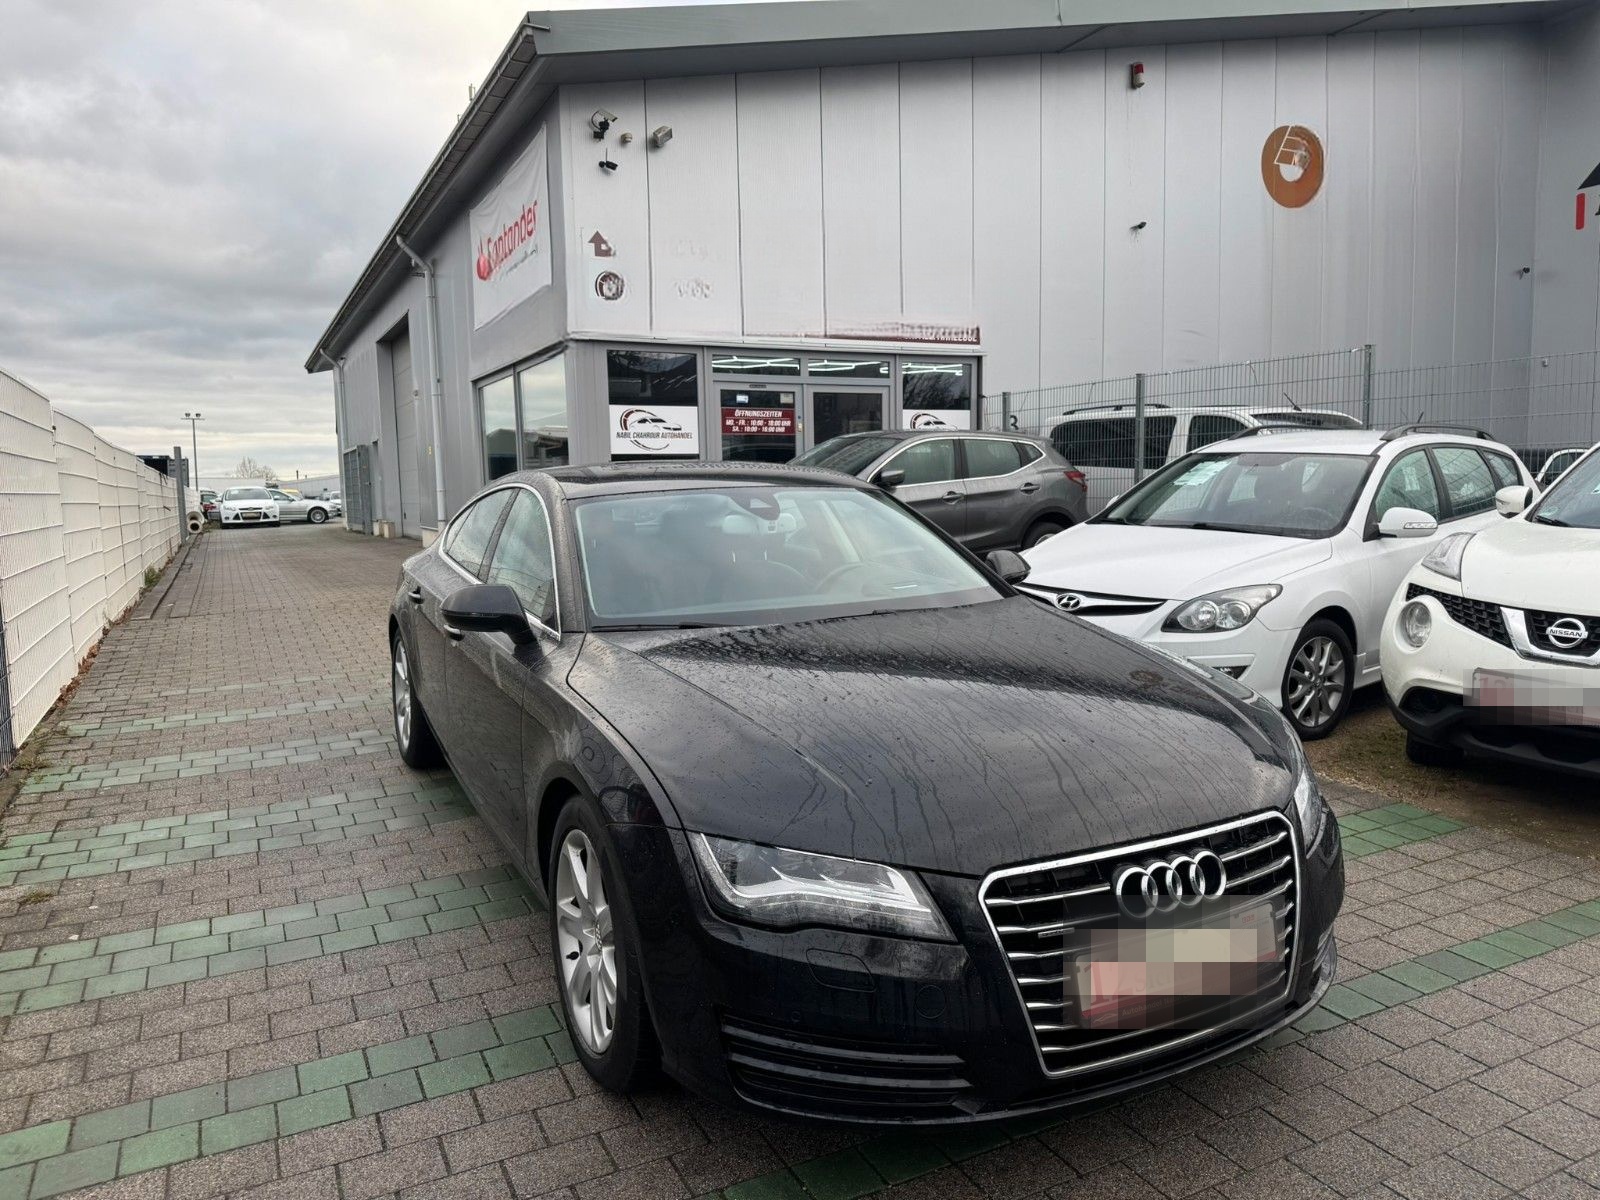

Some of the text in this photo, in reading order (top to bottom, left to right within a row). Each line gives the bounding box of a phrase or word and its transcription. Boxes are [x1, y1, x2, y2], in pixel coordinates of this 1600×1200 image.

[487, 200, 538, 271] Santander
[734, 409, 782, 417] ÖFFNUNGSZEITEN
[616, 431, 631, 439] NABIL
[1549, 628, 1583, 637] NISSAN
